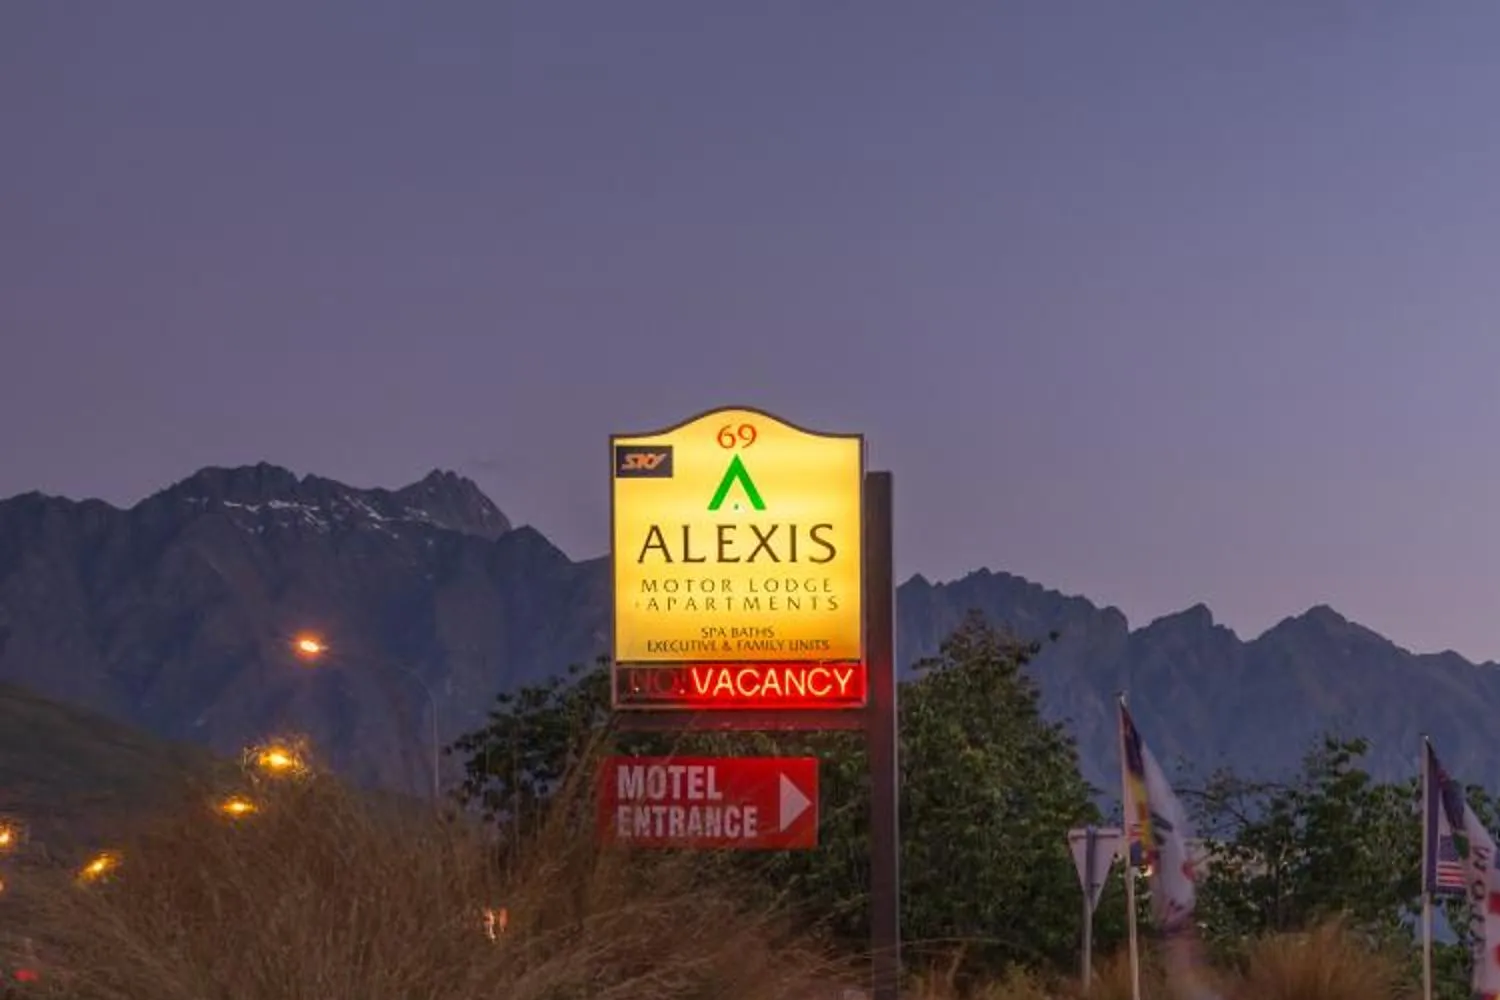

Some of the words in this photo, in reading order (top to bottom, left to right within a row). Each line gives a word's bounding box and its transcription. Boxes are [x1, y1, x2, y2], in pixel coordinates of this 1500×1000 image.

[716, 423, 758, 449] 69
[637, 523, 837, 564] ALEXIS
[641, 578, 733, 593] MOTOR
[749, 578, 832, 593] LODGE
[646, 596, 839, 612] APARTMENTS
[647, 639, 716, 652] EXECUTIVE
[737, 639, 785, 652] FAMILY
[789, 639, 831, 652] UNITS
[701, 627, 727, 639] SPA
[731, 626, 775, 639] BATHS
[691, 668, 853, 697] VACANCY
[617, 765, 723, 799] MOTEL
[616, 806, 758, 838] ENTRANCE
